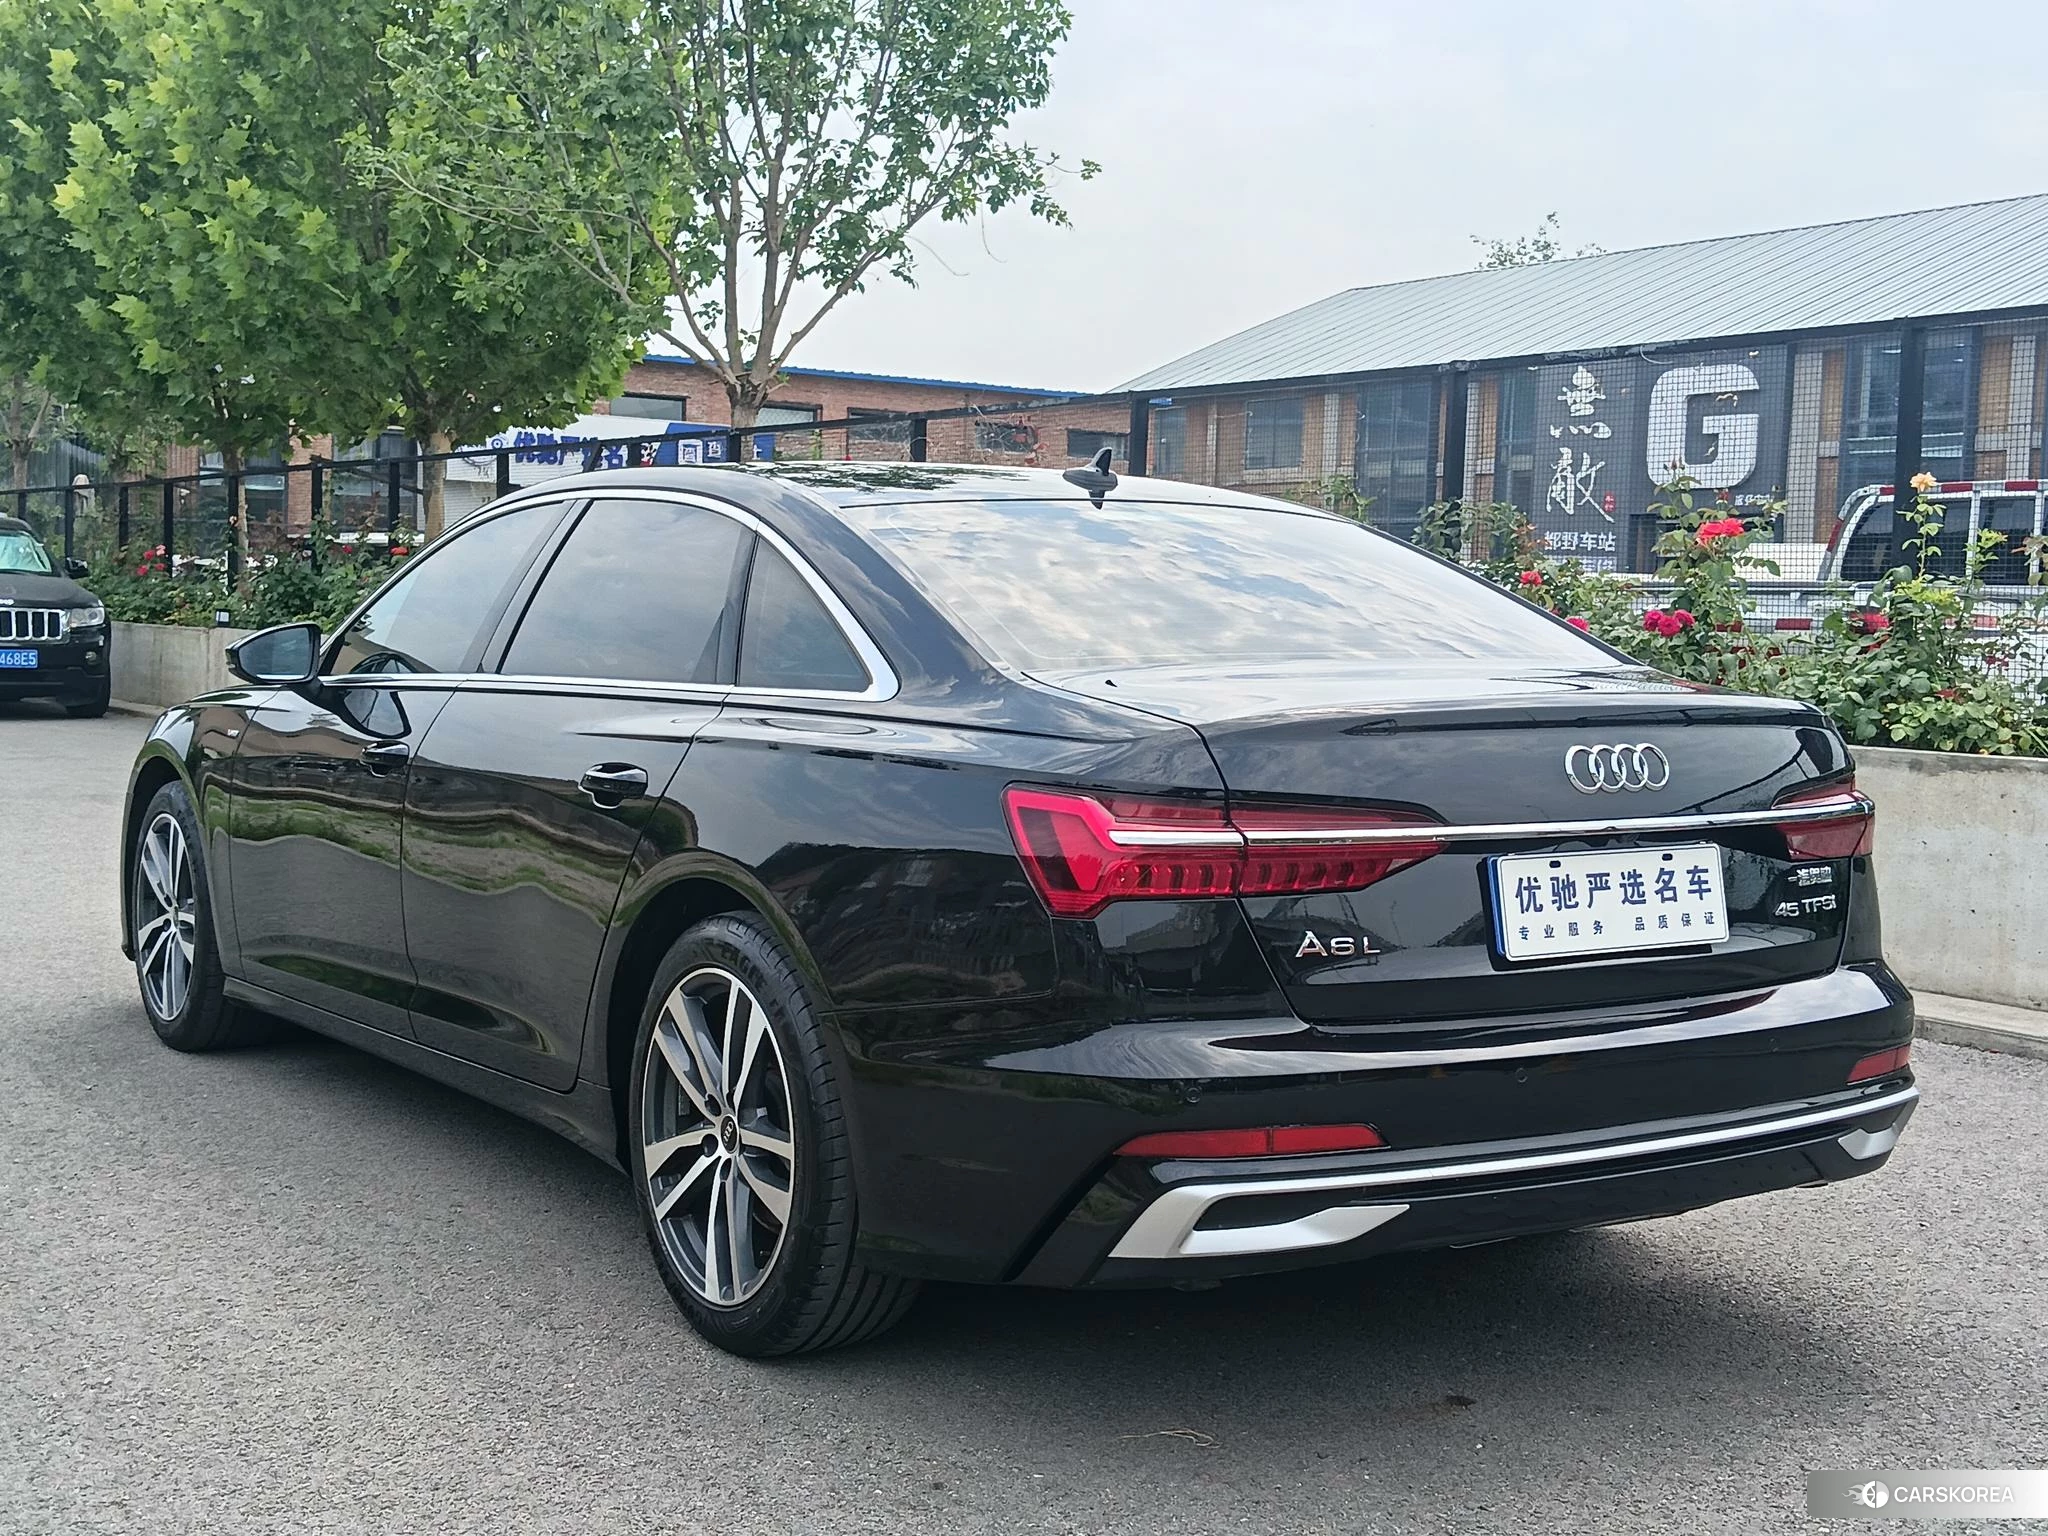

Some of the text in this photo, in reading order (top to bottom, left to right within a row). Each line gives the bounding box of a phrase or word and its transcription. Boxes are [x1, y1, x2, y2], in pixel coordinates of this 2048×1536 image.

[1647, 364, 1760, 489] G
[1515, 865, 1712, 914] 优驰严选名车
[1518, 911, 1715, 940] 专业服务 品质保证
[1775, 902, 1799, 917] 45
